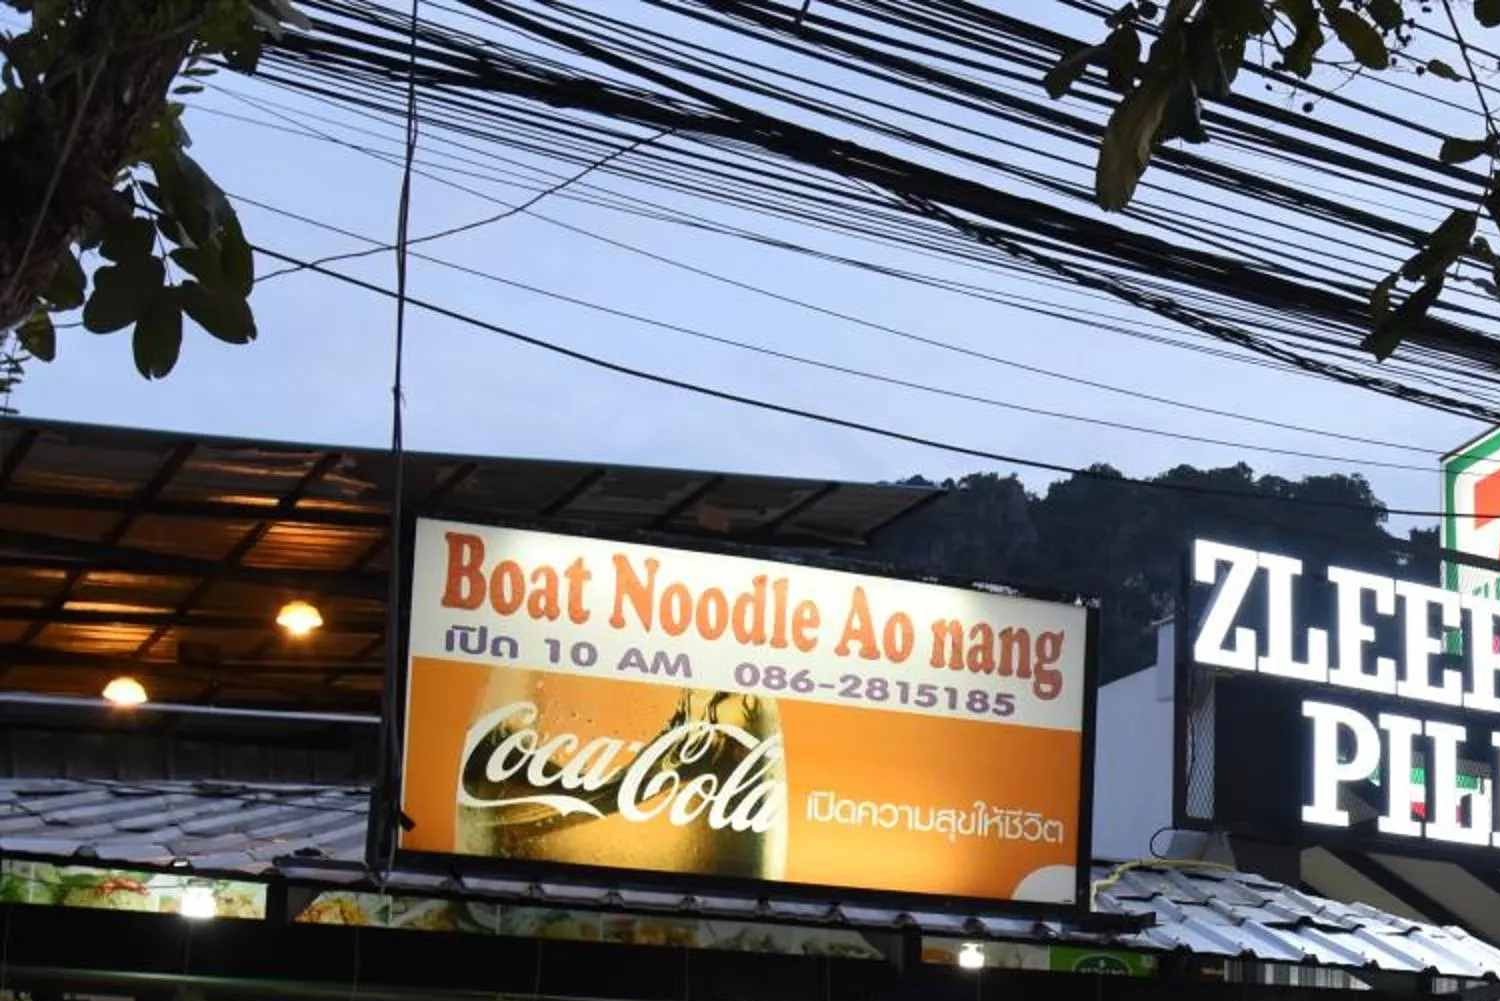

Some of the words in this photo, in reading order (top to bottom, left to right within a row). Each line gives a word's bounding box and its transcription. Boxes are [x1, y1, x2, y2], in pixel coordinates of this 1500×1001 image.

[441, 530, 591, 624] Boat
[609, 551, 821, 654] Noodle
[834, 584, 914, 664] Ao
[927, 612, 1066, 702] nang
[445, 624, 519, 660] เปิด
[544, 637, 599, 668] 10
[617, 647, 693, 678] AM
[733, 661, 1016, 718] 086-2815185
[806, 790, 1064, 844] เปิดความสุขให้ชีวิต
